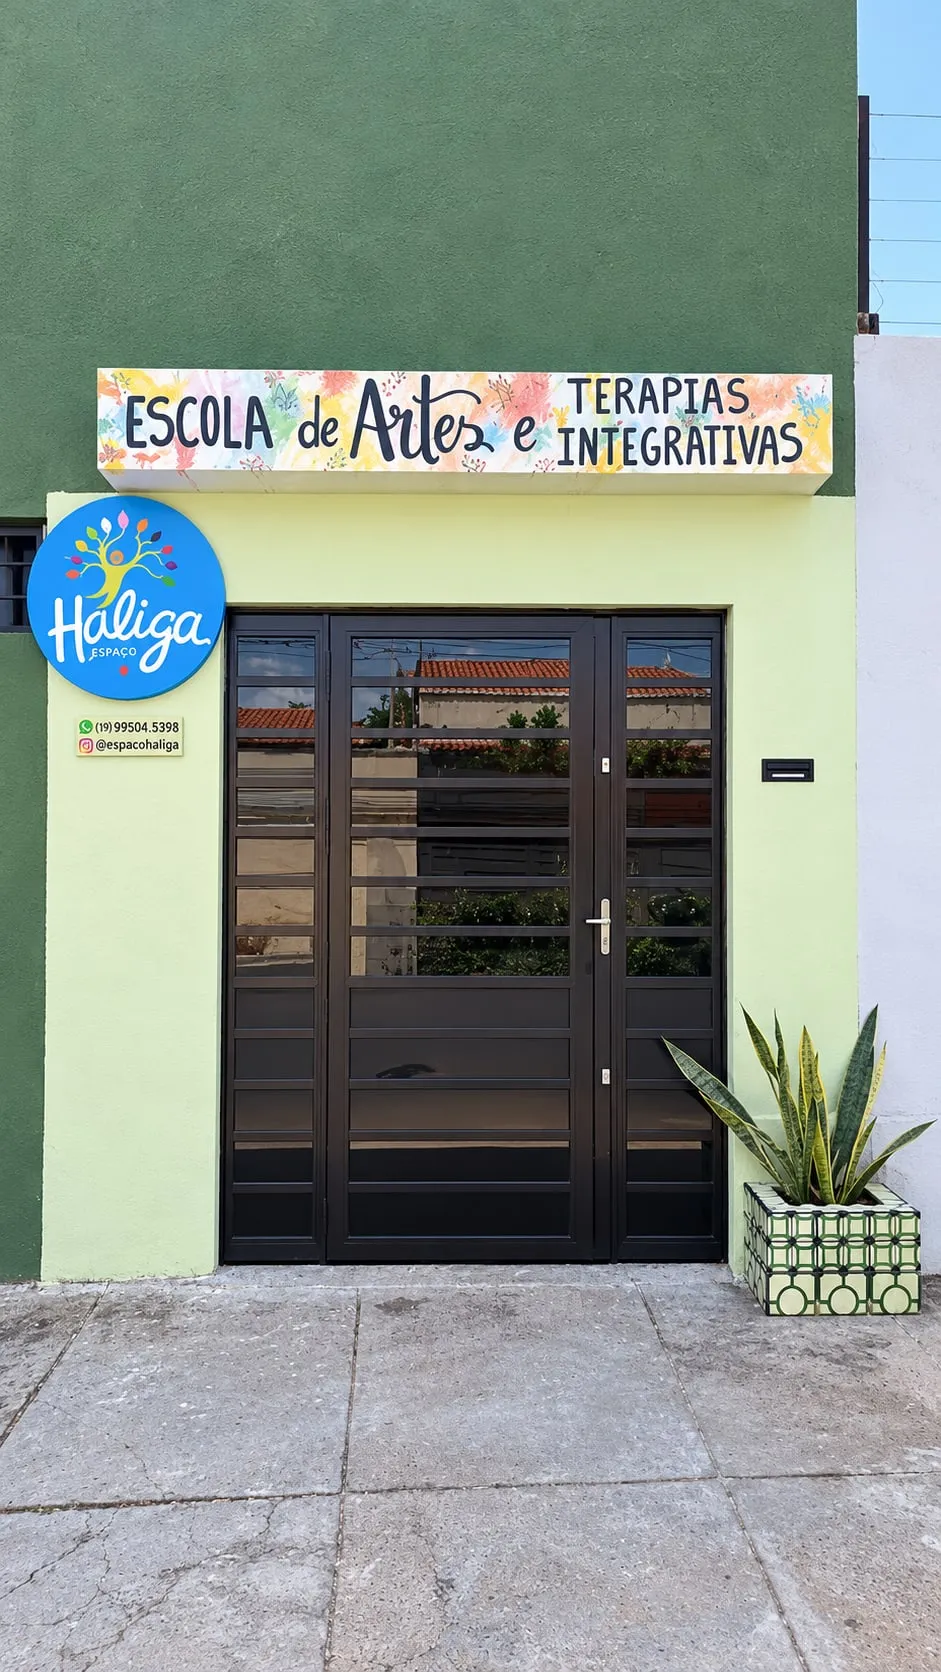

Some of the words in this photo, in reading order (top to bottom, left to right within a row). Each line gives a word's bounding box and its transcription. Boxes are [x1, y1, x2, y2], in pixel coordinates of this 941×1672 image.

[567, 377, 750, 414] TERAPIAS
[126, 395, 274, 450] ESCOLA
[298, 395, 339, 448] de
[350, 374, 495, 465] Artes
[514, 416, 537, 452] e
[557, 422, 803, 467] INTEGRATIVAS
[48, 589, 211, 674] Haliga
[90, 647, 137, 659] ESPAÇO
[95, 722, 113, 734] (19)
[114, 721, 179, 733] 99504.5398
[95, 739, 179, 753] @espacohaliga
